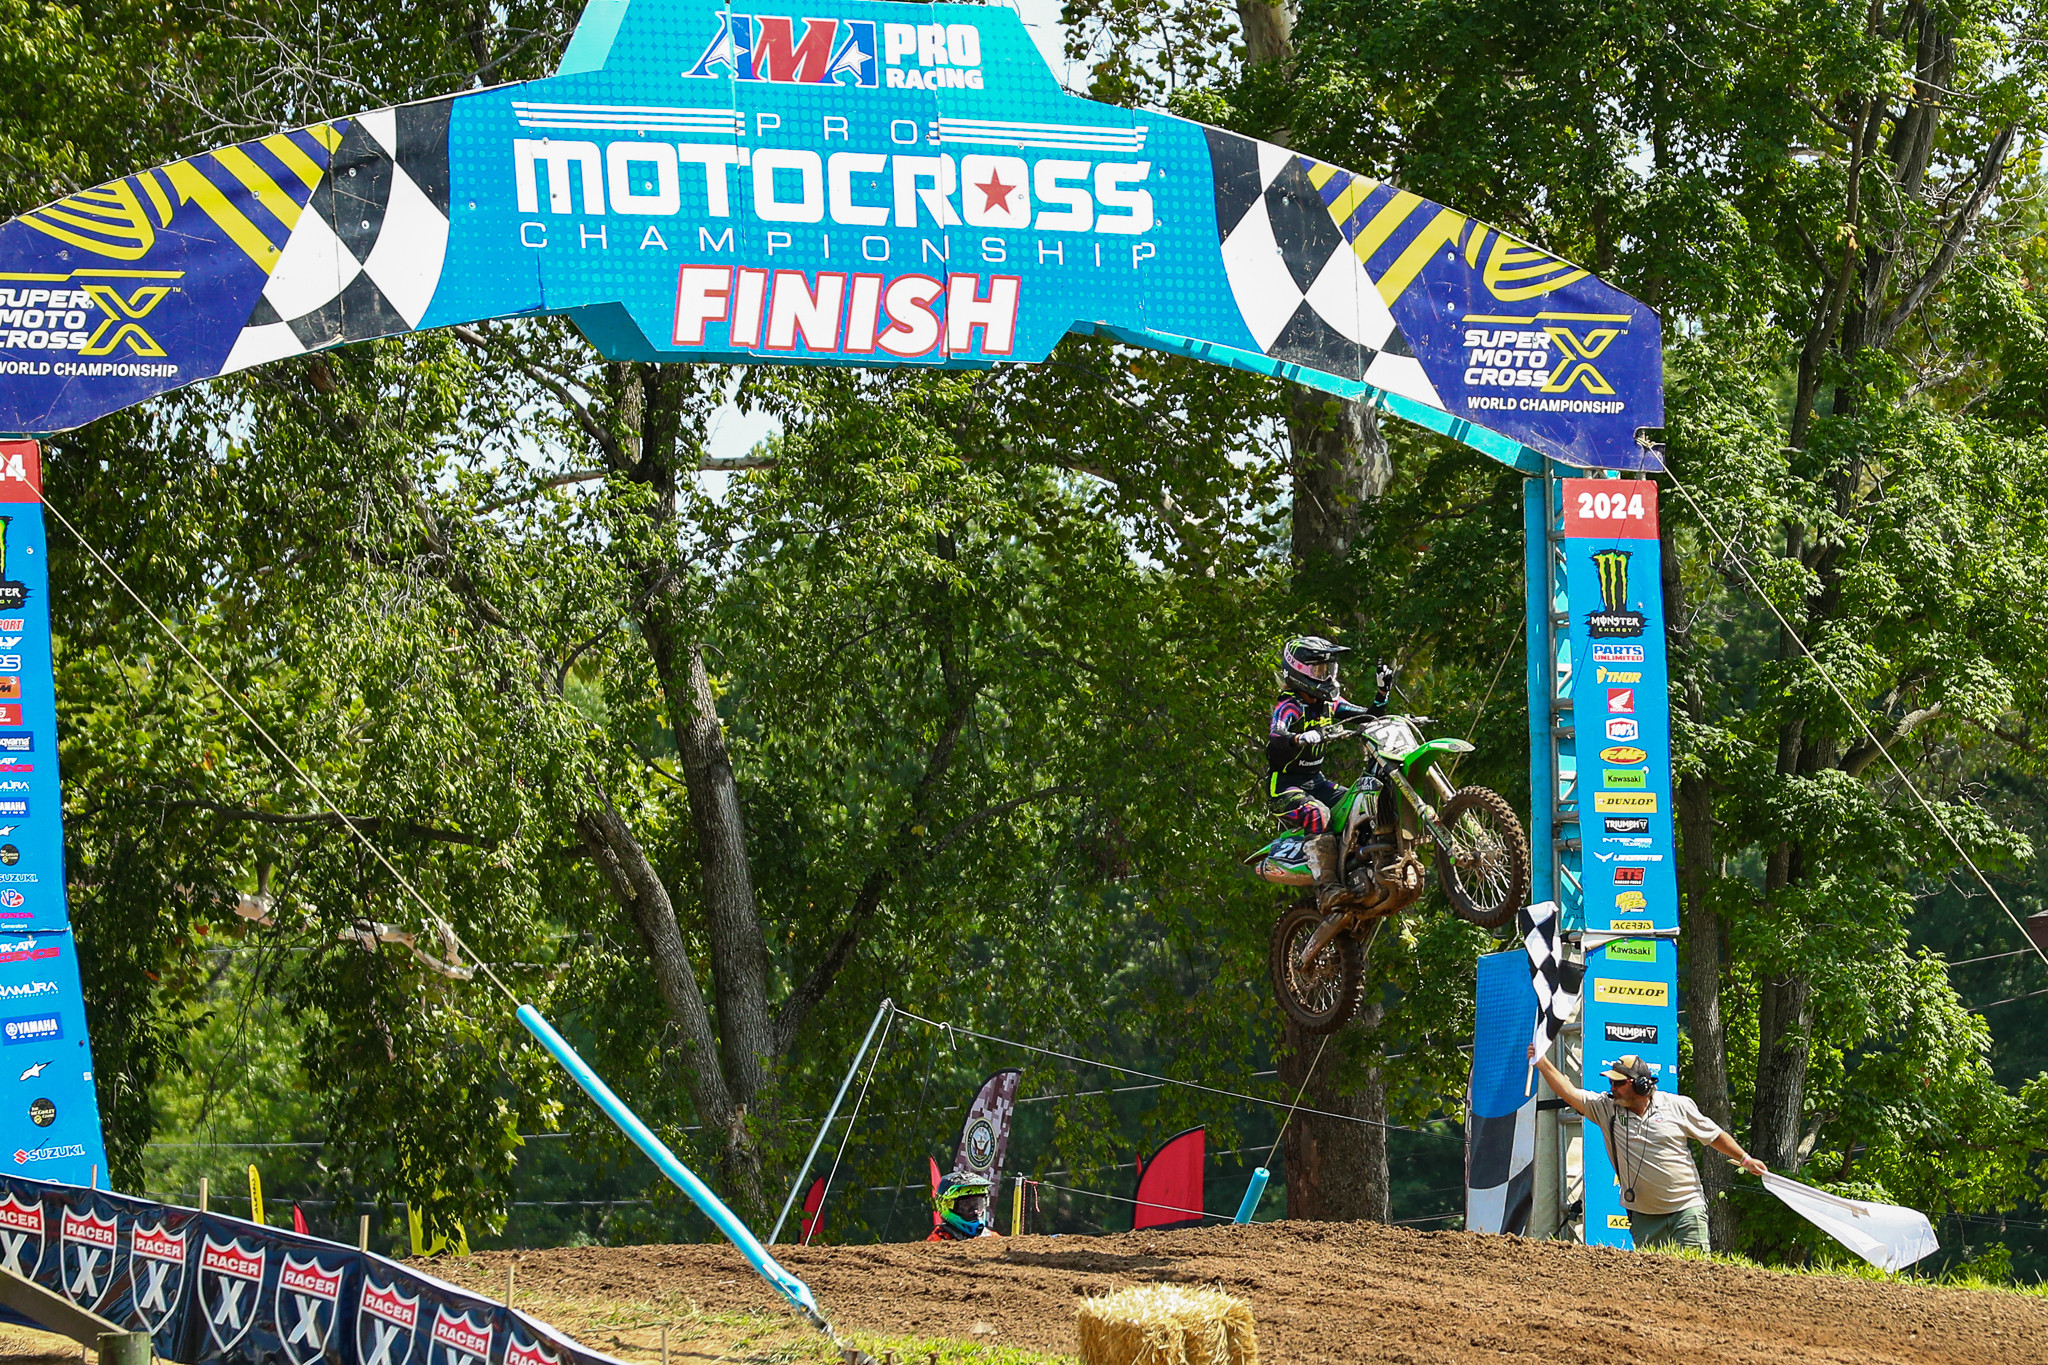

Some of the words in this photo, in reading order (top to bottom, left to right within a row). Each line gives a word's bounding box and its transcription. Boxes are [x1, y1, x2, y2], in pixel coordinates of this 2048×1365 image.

[681, 11, 880, 88] AMA
[884, 23, 982, 67] PRO
[886, 67, 985, 90] RACING
[757, 112, 919, 145] PRO
[513, 138, 1154, 234] MOTOCROSS
[520, 221, 1156, 269] CHAMPIONSHIP
[672, 263, 1022, 357] FINISH
[1463, 329, 1551, 349] SUPER
[1469, 348, 1548, 368] MOTO
[54, 362, 178, 377] CHAMPIONSHIP
[1463, 368, 1550, 387] CROSS
[1467, 396, 1517, 410] WORLD
[1519, 398, 1625, 414] CHAMPIONSHIP
[1577, 492, 1645, 519] 2024
[1591, 615, 1640, 627] MONSTER
[1594, 645, 1642, 655] PARTS
[1606, 671, 1642, 683] THOR
[1610, 723, 1634, 736] 100%
[1607, 775, 1641, 783] Kawasaki
[1607, 798, 1653, 806] DUNLOP
[1605, 820, 1639, 830] TRIUMPH
[1274, 842, 1303, 858] 21
[1615, 868, 1643, 880] ETS
[1610, 945, 1651, 956] Kawasaki
[1608, 986, 1664, 997] DUNLOP
[17, 1019, 58, 1034] YAMAHA
[1605, 1025, 1646, 1039] TRIUMPH
[28, 1144, 84, 1161] SUZUKI
[66, 1222, 113, 1243] RACER
[136, 1237, 181, 1259] RACER
[206, 1253, 259, 1276] RACER
[284, 1271, 336, 1295] RACER
[364, 1293, 413, 1323] RACER
[436, 1323, 486, 1351] RACER
